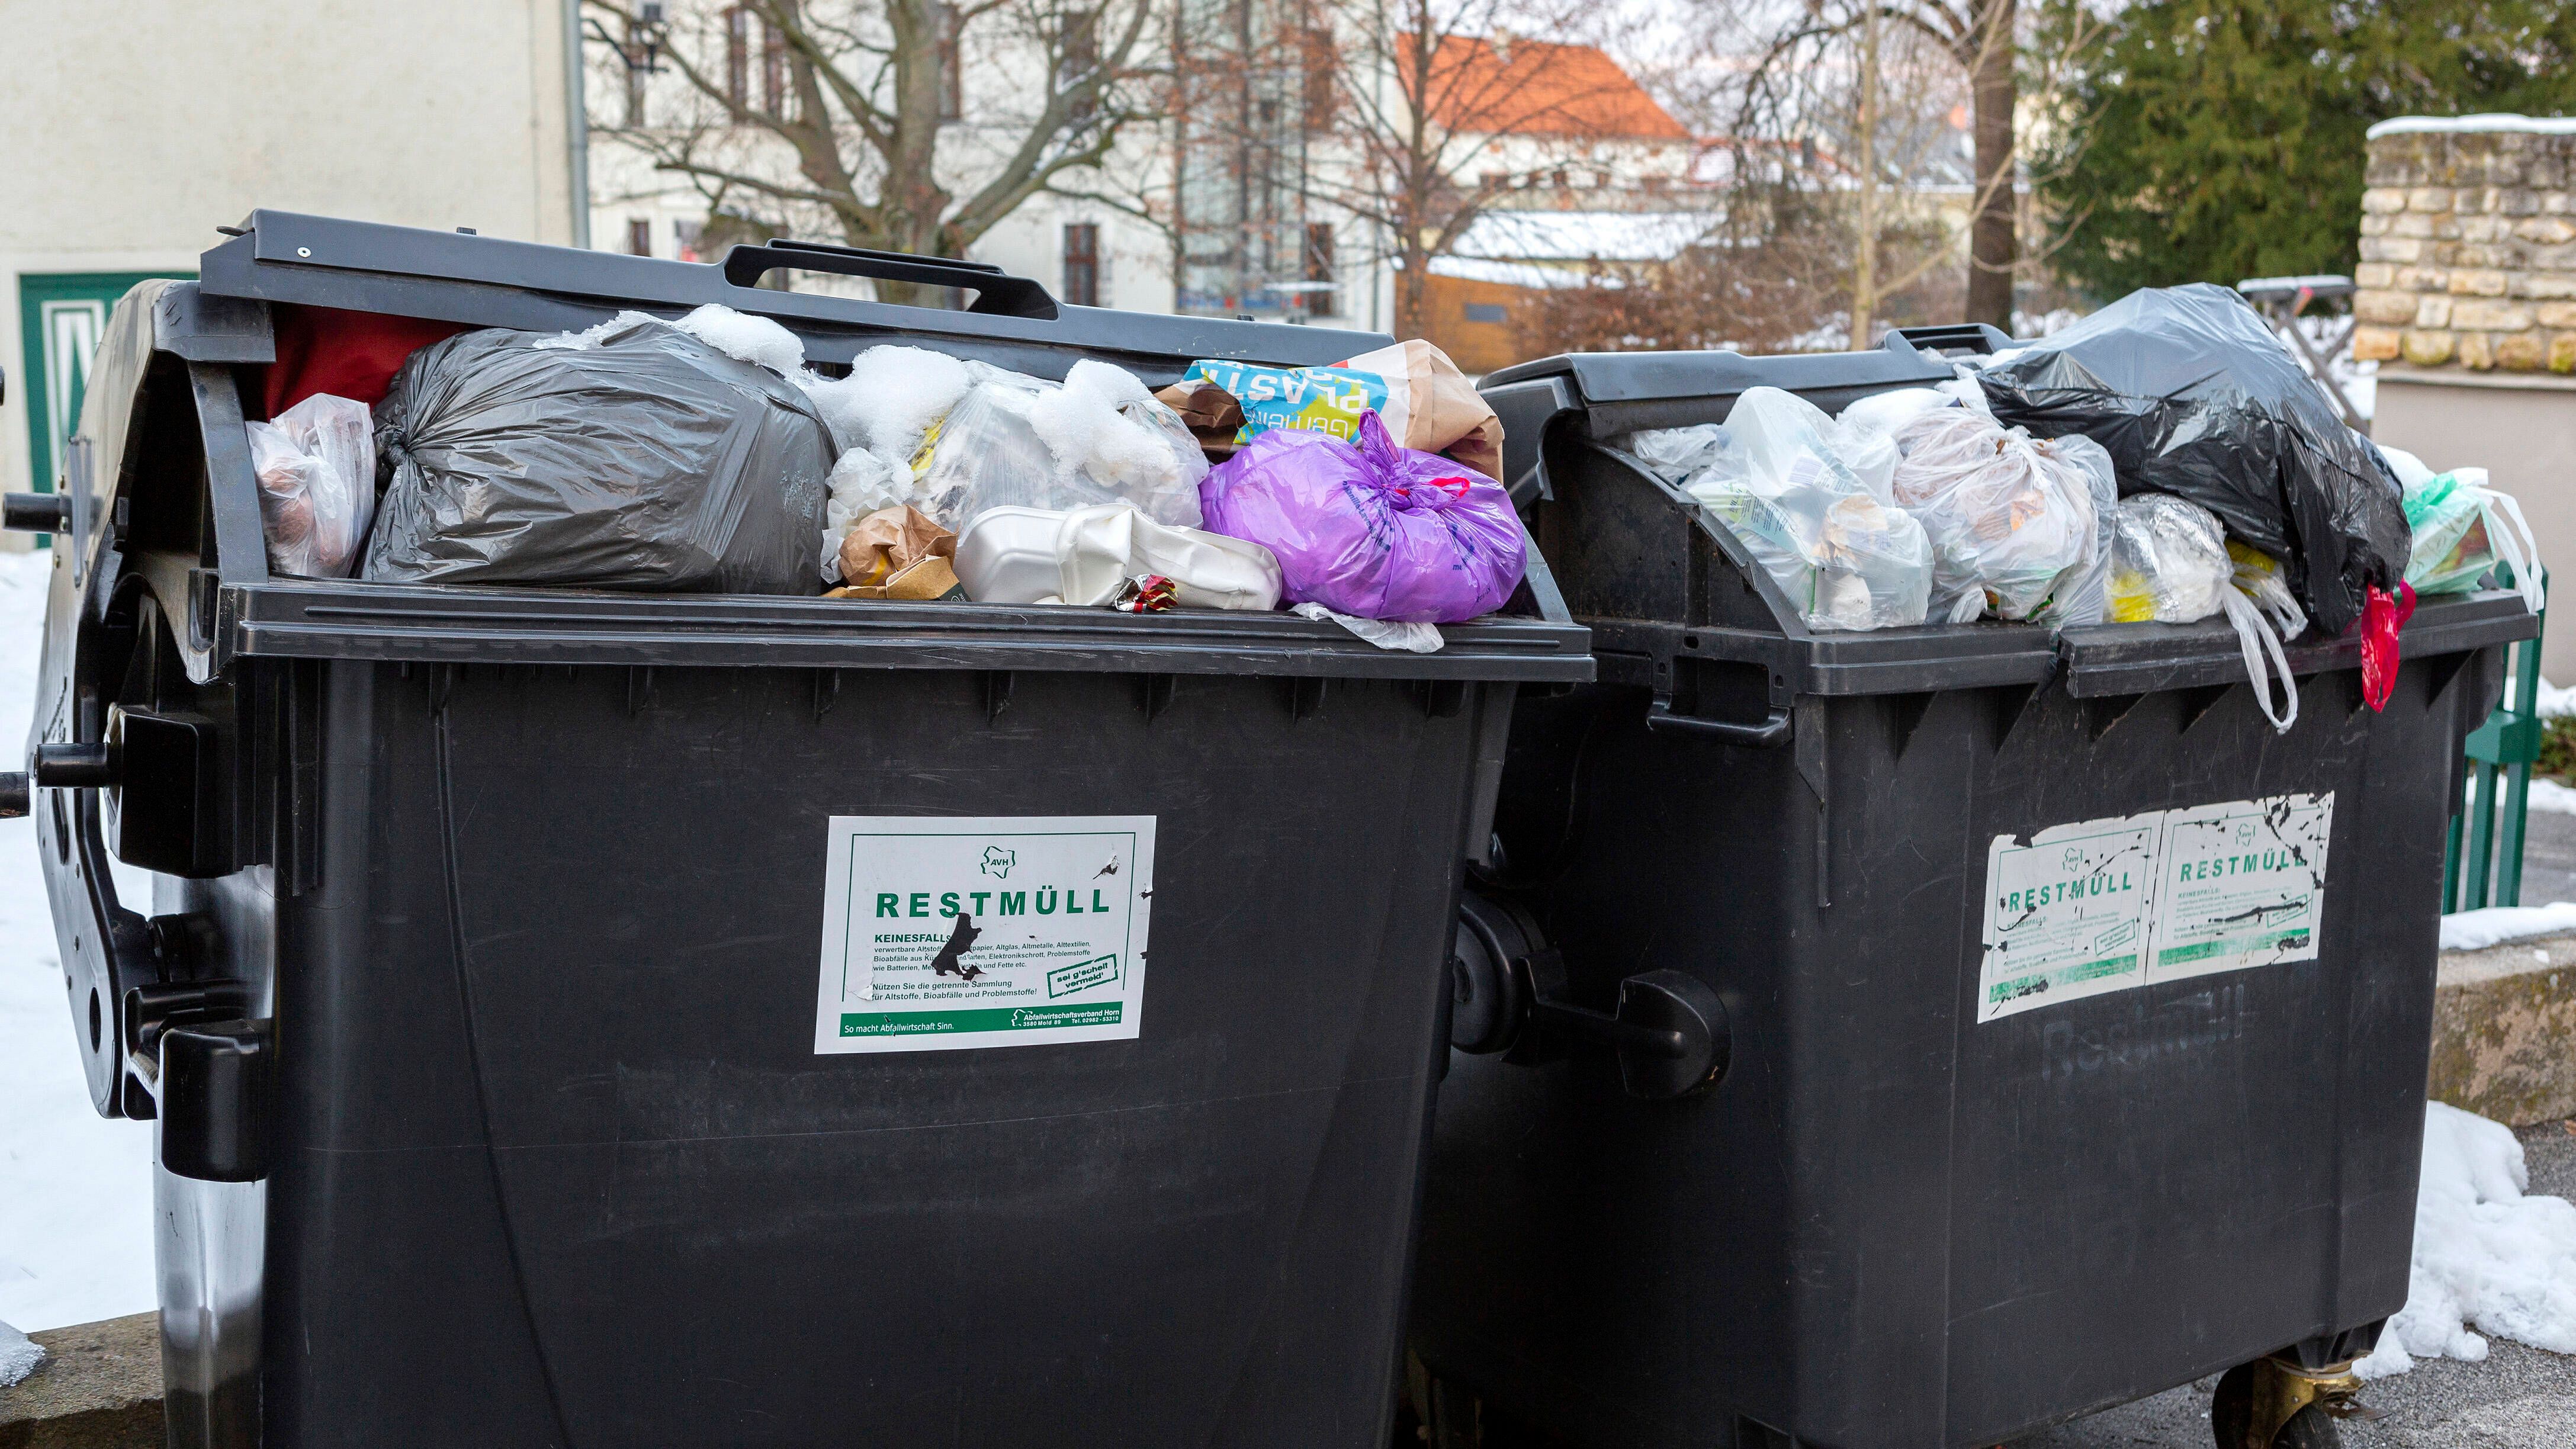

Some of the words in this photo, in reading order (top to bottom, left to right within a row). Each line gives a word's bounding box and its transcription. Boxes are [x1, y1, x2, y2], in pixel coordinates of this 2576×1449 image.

[1202, 368, 1367, 414] PLAST
[990, 858, 1008, 866] AVH
[2009, 872, 2132, 913] RESTMÜLL
[876, 885, 1109, 918] RESTMÜLL
[988, 952, 1045, 960] Elektronikschrott,
[1057, 974, 1071, 983] sei
[932, 982, 969, 992] getrennte
[872, 993, 883, 1001] für
[923, 991, 963, 1000] Bioabfälle
[982, 988, 1037, 997] Problemstoffe!
[1023, 1010, 1103, 1020] Abfallwirtschaftsverband
[844, 1025, 854, 1033] So
[856, 1024, 878, 1033] macht
[880, 1023, 935, 1032] Abfallwirtschaft
